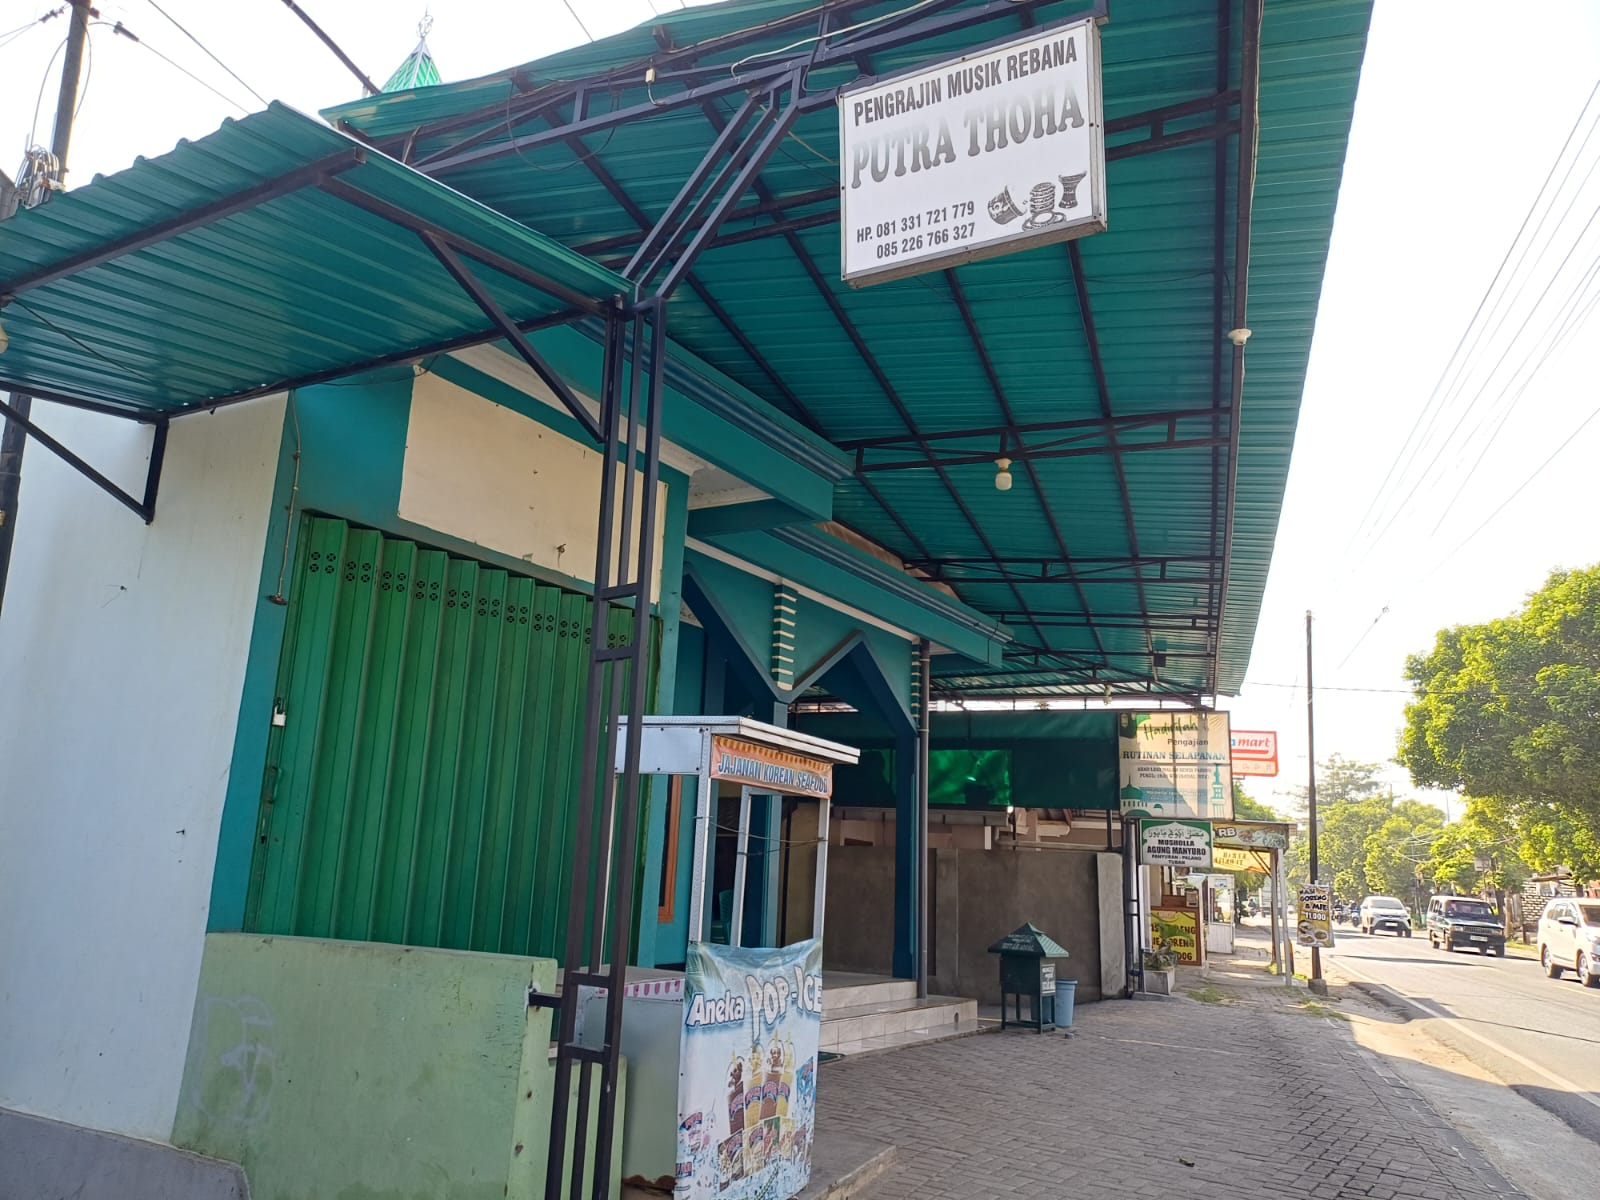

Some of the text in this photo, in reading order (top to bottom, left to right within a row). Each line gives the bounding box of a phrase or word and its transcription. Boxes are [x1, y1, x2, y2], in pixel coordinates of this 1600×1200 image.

[854, 36, 1077, 126] PENGRAJIN MUSIK REBANA
[851, 80, 1085, 189] PUTRA THOHA
[857, 200, 975, 243] HP. 081 331 721 779
[877, 222, 976, 259] 085 226 766 327
[1123, 751, 1225, 760] RUTINAN SELAPANAN
[1167, 738, 1208, 747] Pengajian
[718, 753, 828, 794] JAJANAN KOREAN SEAFOOD
[1147, 846, 1206, 855] AGUNG MANYURO
[1312, 903, 1328, 911] MIE
[685, 964, 822, 1042] Aneka POP-ICE
